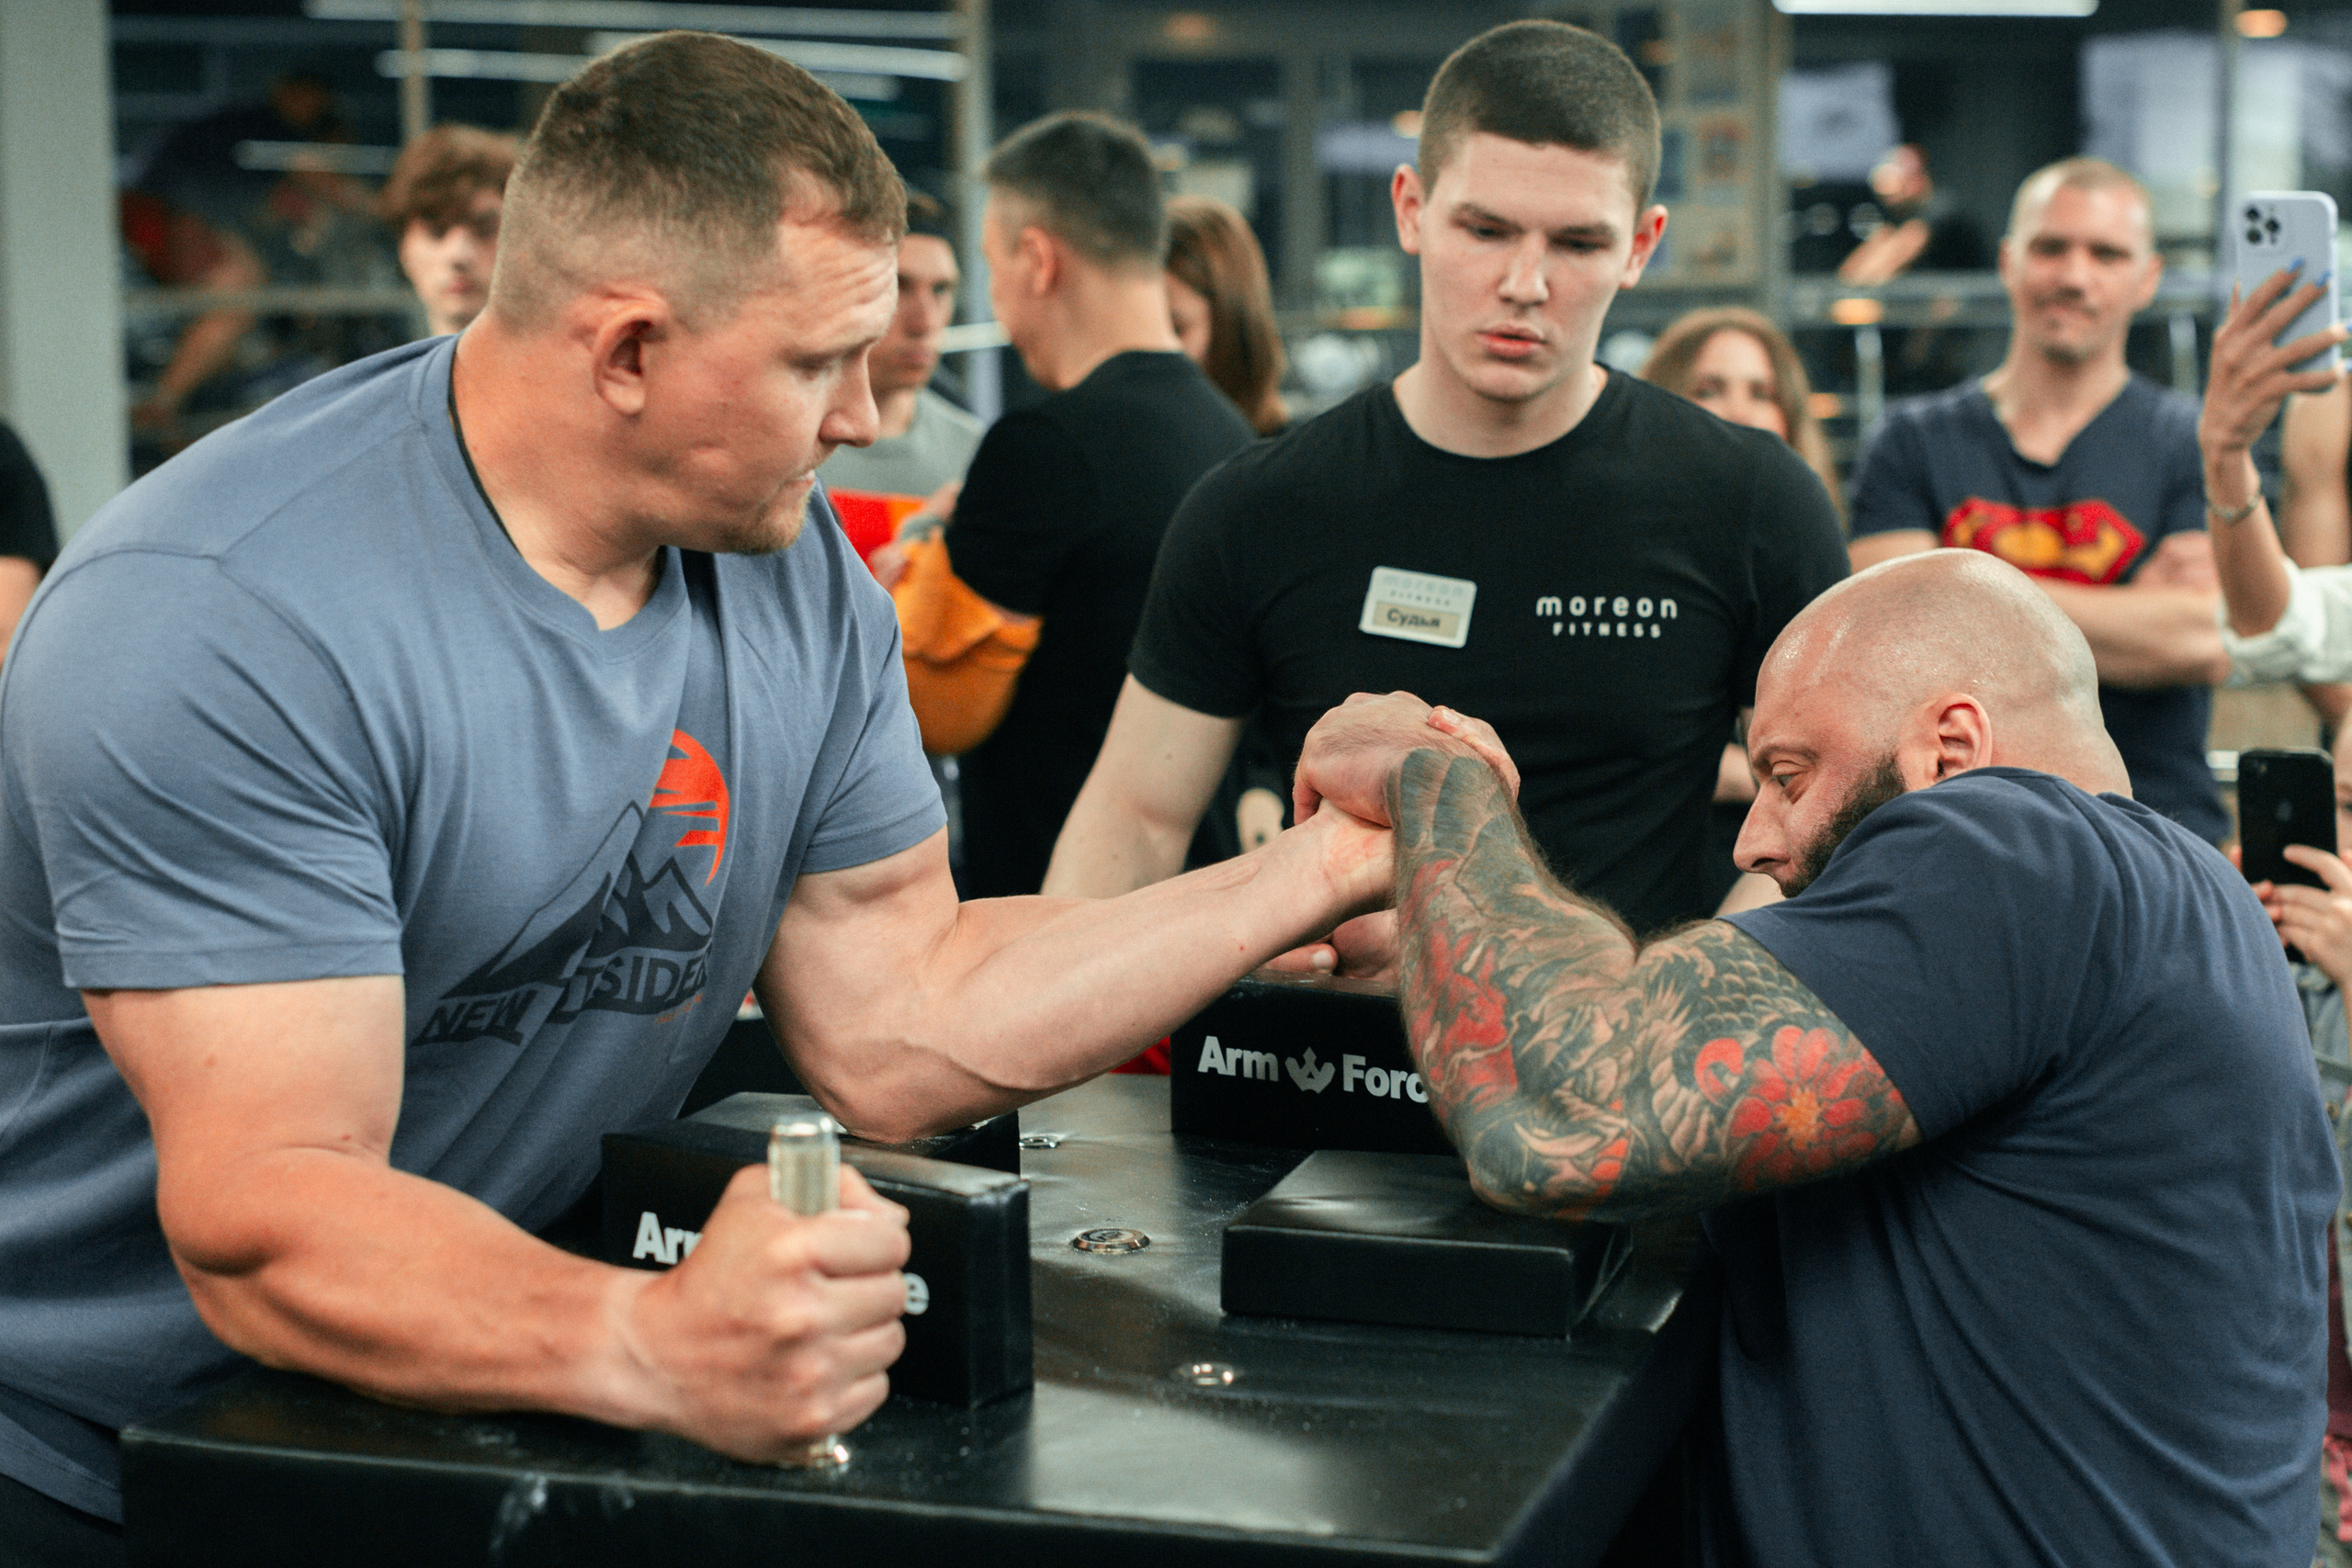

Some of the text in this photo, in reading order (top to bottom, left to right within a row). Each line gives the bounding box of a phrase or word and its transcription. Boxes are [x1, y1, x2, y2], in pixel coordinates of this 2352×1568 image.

[1386, 607, 1441, 627] Судья
[1536, 596, 1678, 619] moreon
[1553, 622, 1660, 637] FITNESS
[415, 989, 538, 1045] NEW
[1197, 1035, 1430, 1103] Arm Forc
